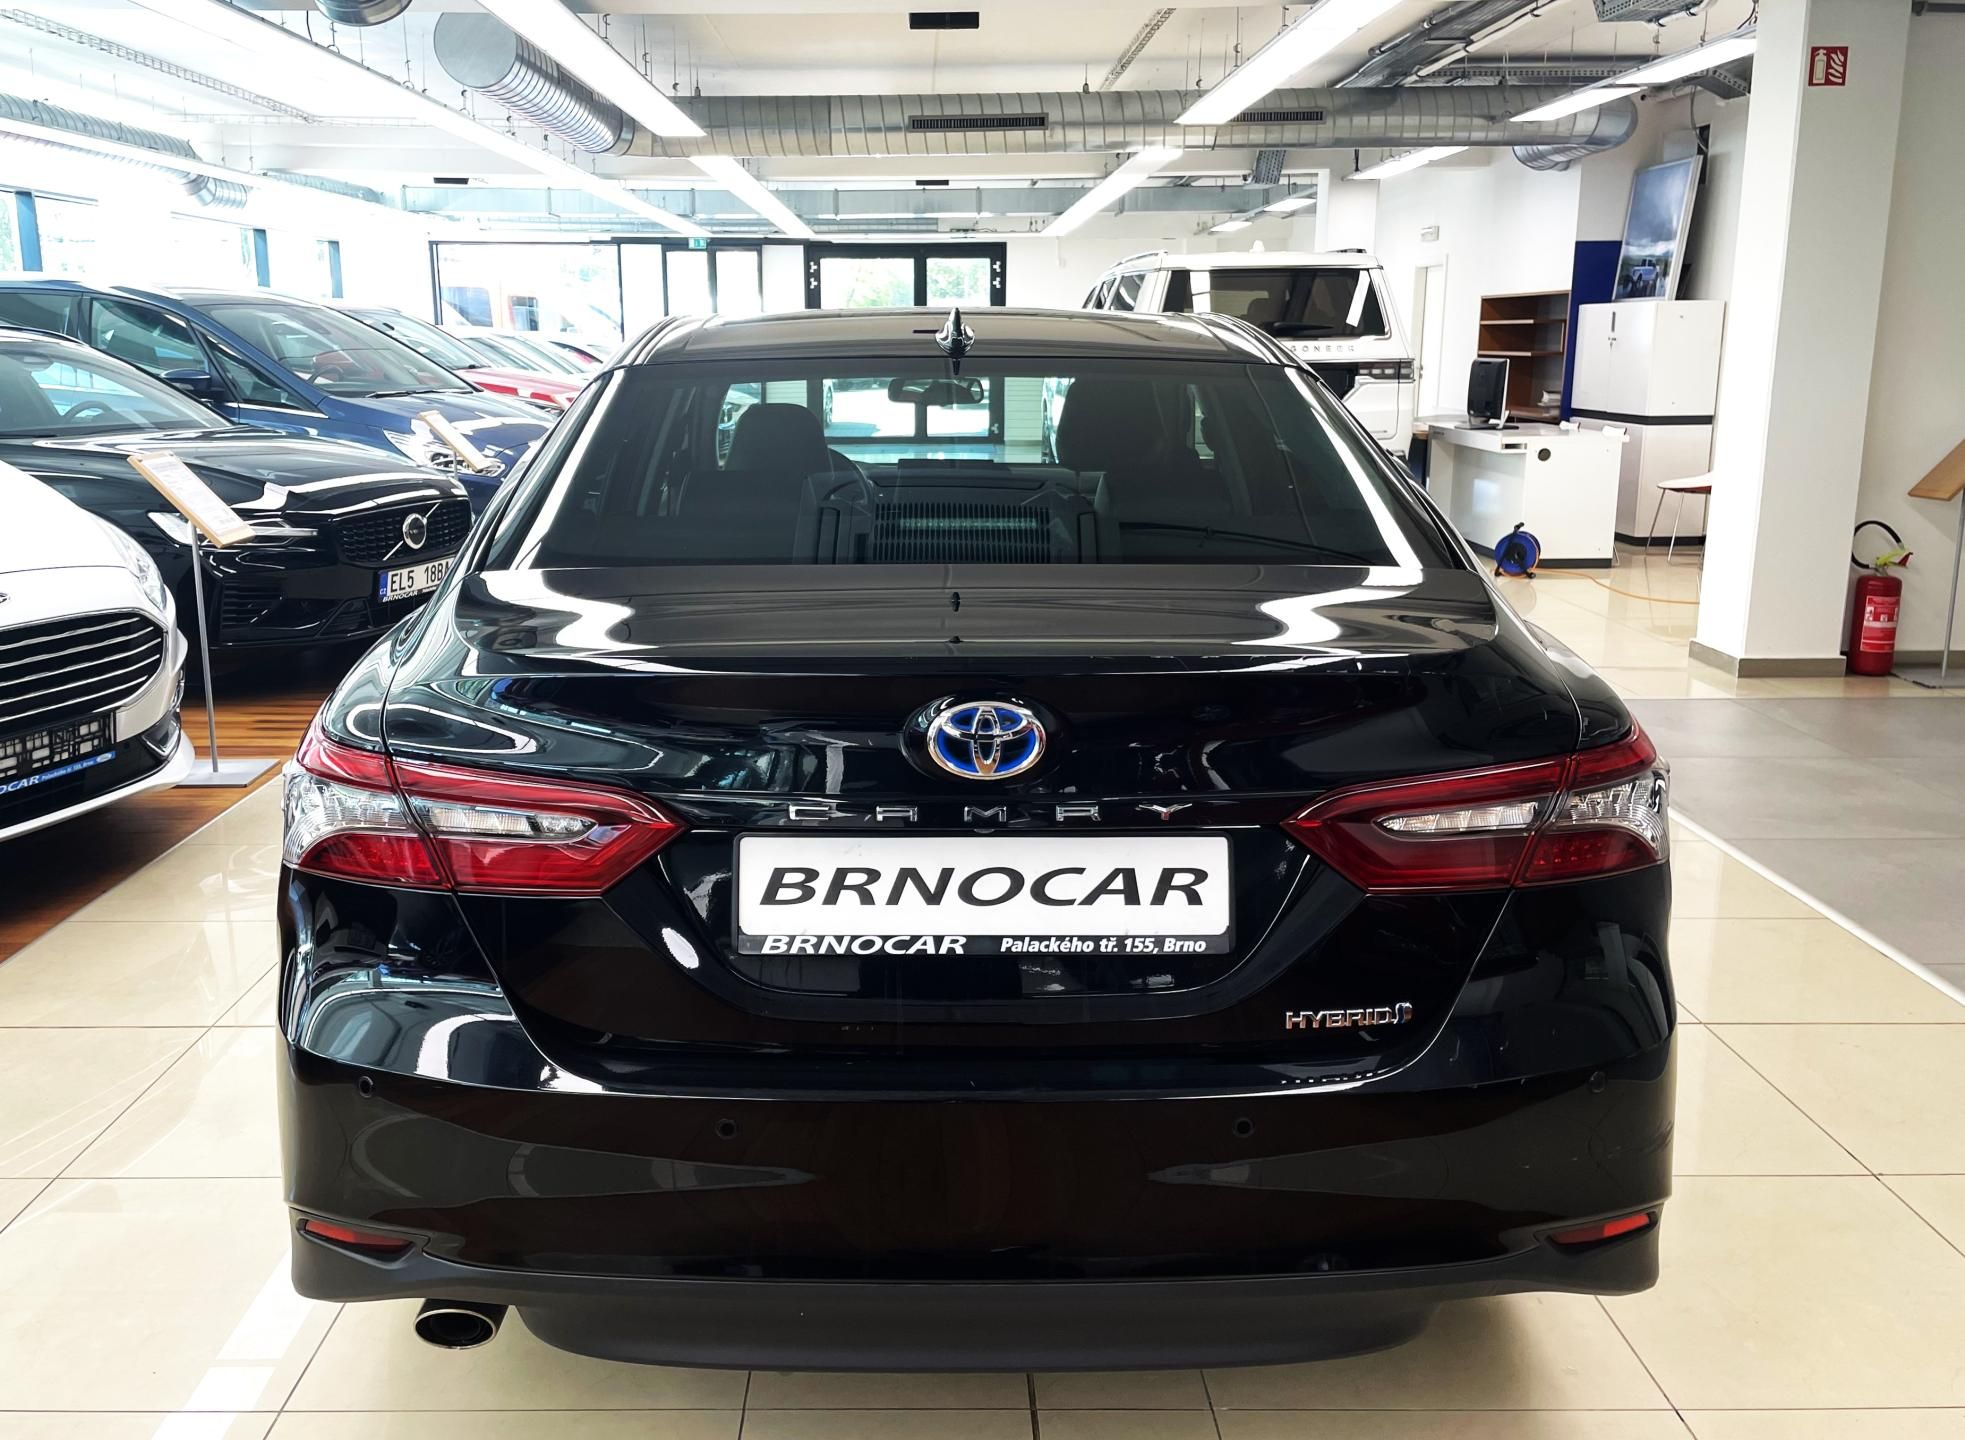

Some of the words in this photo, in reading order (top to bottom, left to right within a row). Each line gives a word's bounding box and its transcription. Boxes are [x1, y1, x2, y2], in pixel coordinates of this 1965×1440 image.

[390, 570, 414, 593] EL5
[789, 804, 1193, 822] CAMRY
[760, 867, 1209, 907] BRNOCAR
[761, 935, 967, 955] BRNOCAR
[1000, 937, 1094, 953] Palackého
[1100, 938, 1118, 953] tř.
[1125, 938, 1158, 955] 155,
[1163, 938, 1207, 953] Brno
[1286, 1008, 1393, 1030] HYBRID
